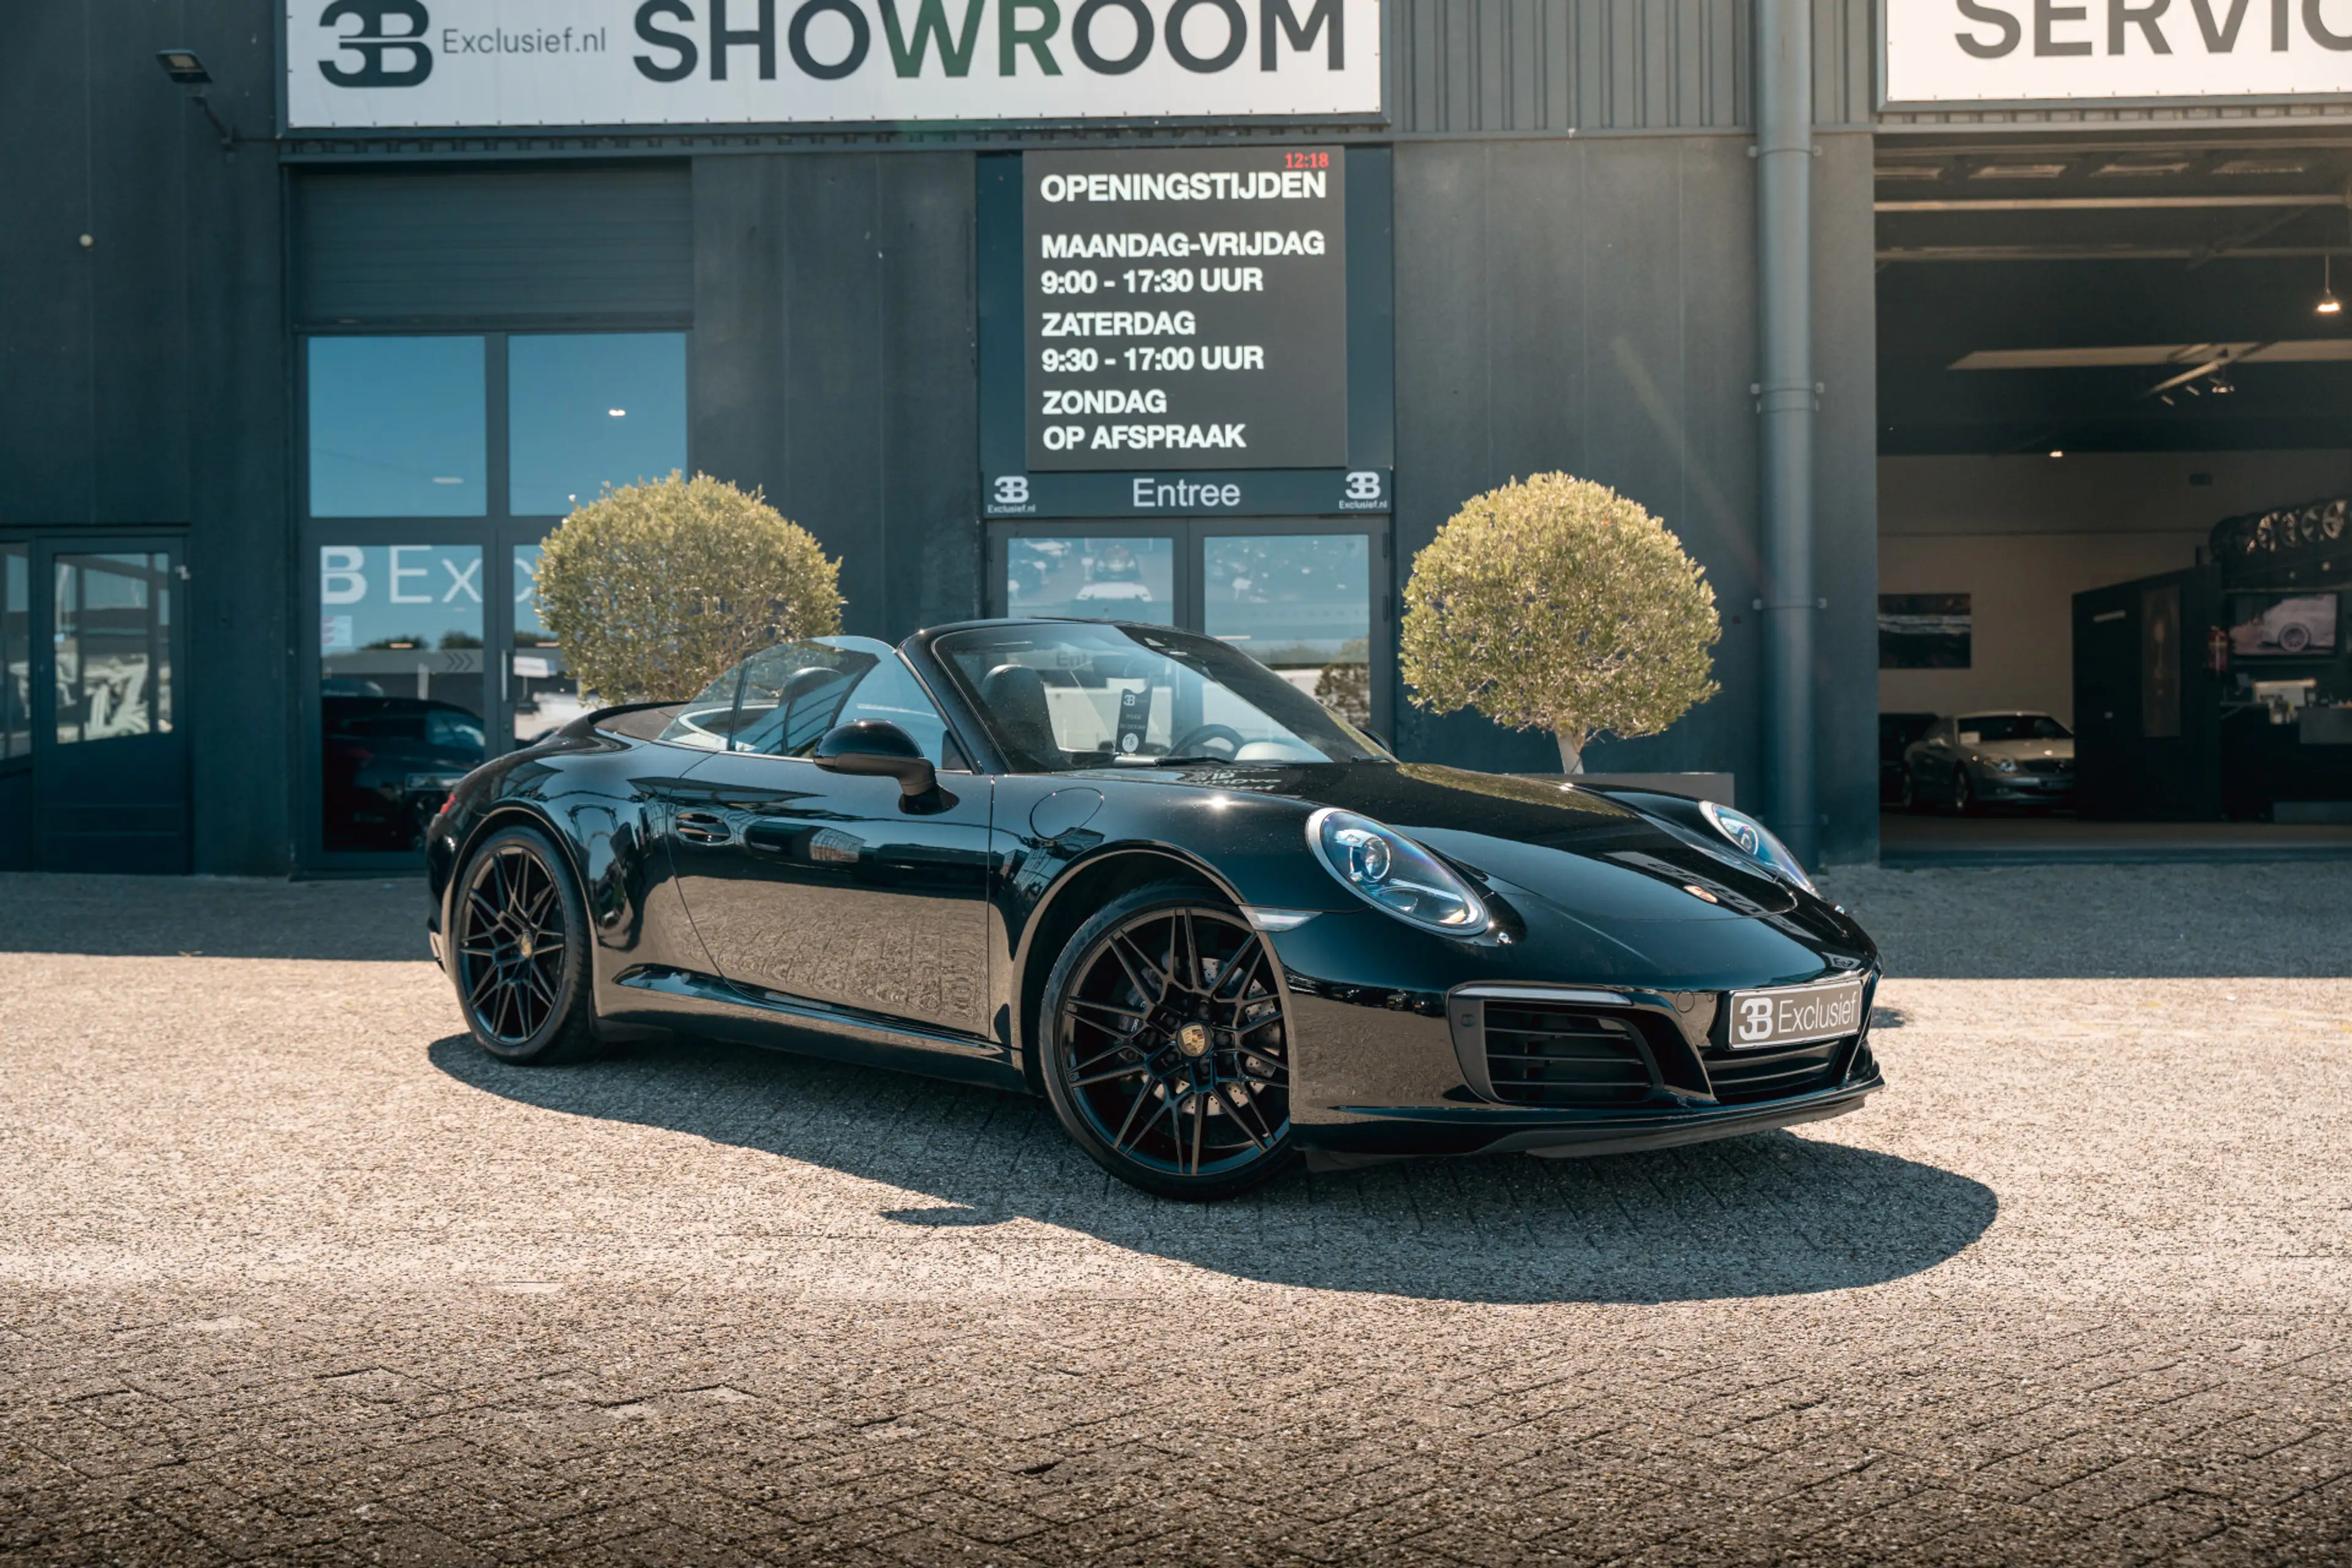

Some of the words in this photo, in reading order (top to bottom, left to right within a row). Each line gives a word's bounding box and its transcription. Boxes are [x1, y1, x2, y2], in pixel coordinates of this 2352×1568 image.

[442, 28, 605, 54] Exclusief.nl
[632, 0, 1345, 83] SHOWROOM
[1284, 152, 1329, 168] 12:18
[1041, 171, 1326, 202] OPENINGSTIJDEN
[1042, 230, 1325, 258] MAANDAG-VRIJDAG
[1041, 270, 1098, 294] 9:00
[1123, 268, 1194, 293] 17:30
[1200, 268, 1264, 292] UUR
[1041, 311, 1196, 336] ZATERDAG
[1041, 349, 1098, 372] 9:30
[1124, 347, 1195, 371] 17:00
[1201, 346, 1264, 370] UUR
[1042, 390, 1167, 415] ZONDAG
[1043, 426, 1085, 450] OP
[1090, 424, 1247, 450] AFSPRAAK
[1133, 478, 1240, 507] Entree
[1338, 500, 1387, 510] Exclusief.nl
[987, 504, 1036, 513] Exclusief.nl
[1778, 991, 1857, 1033] Exclusief
